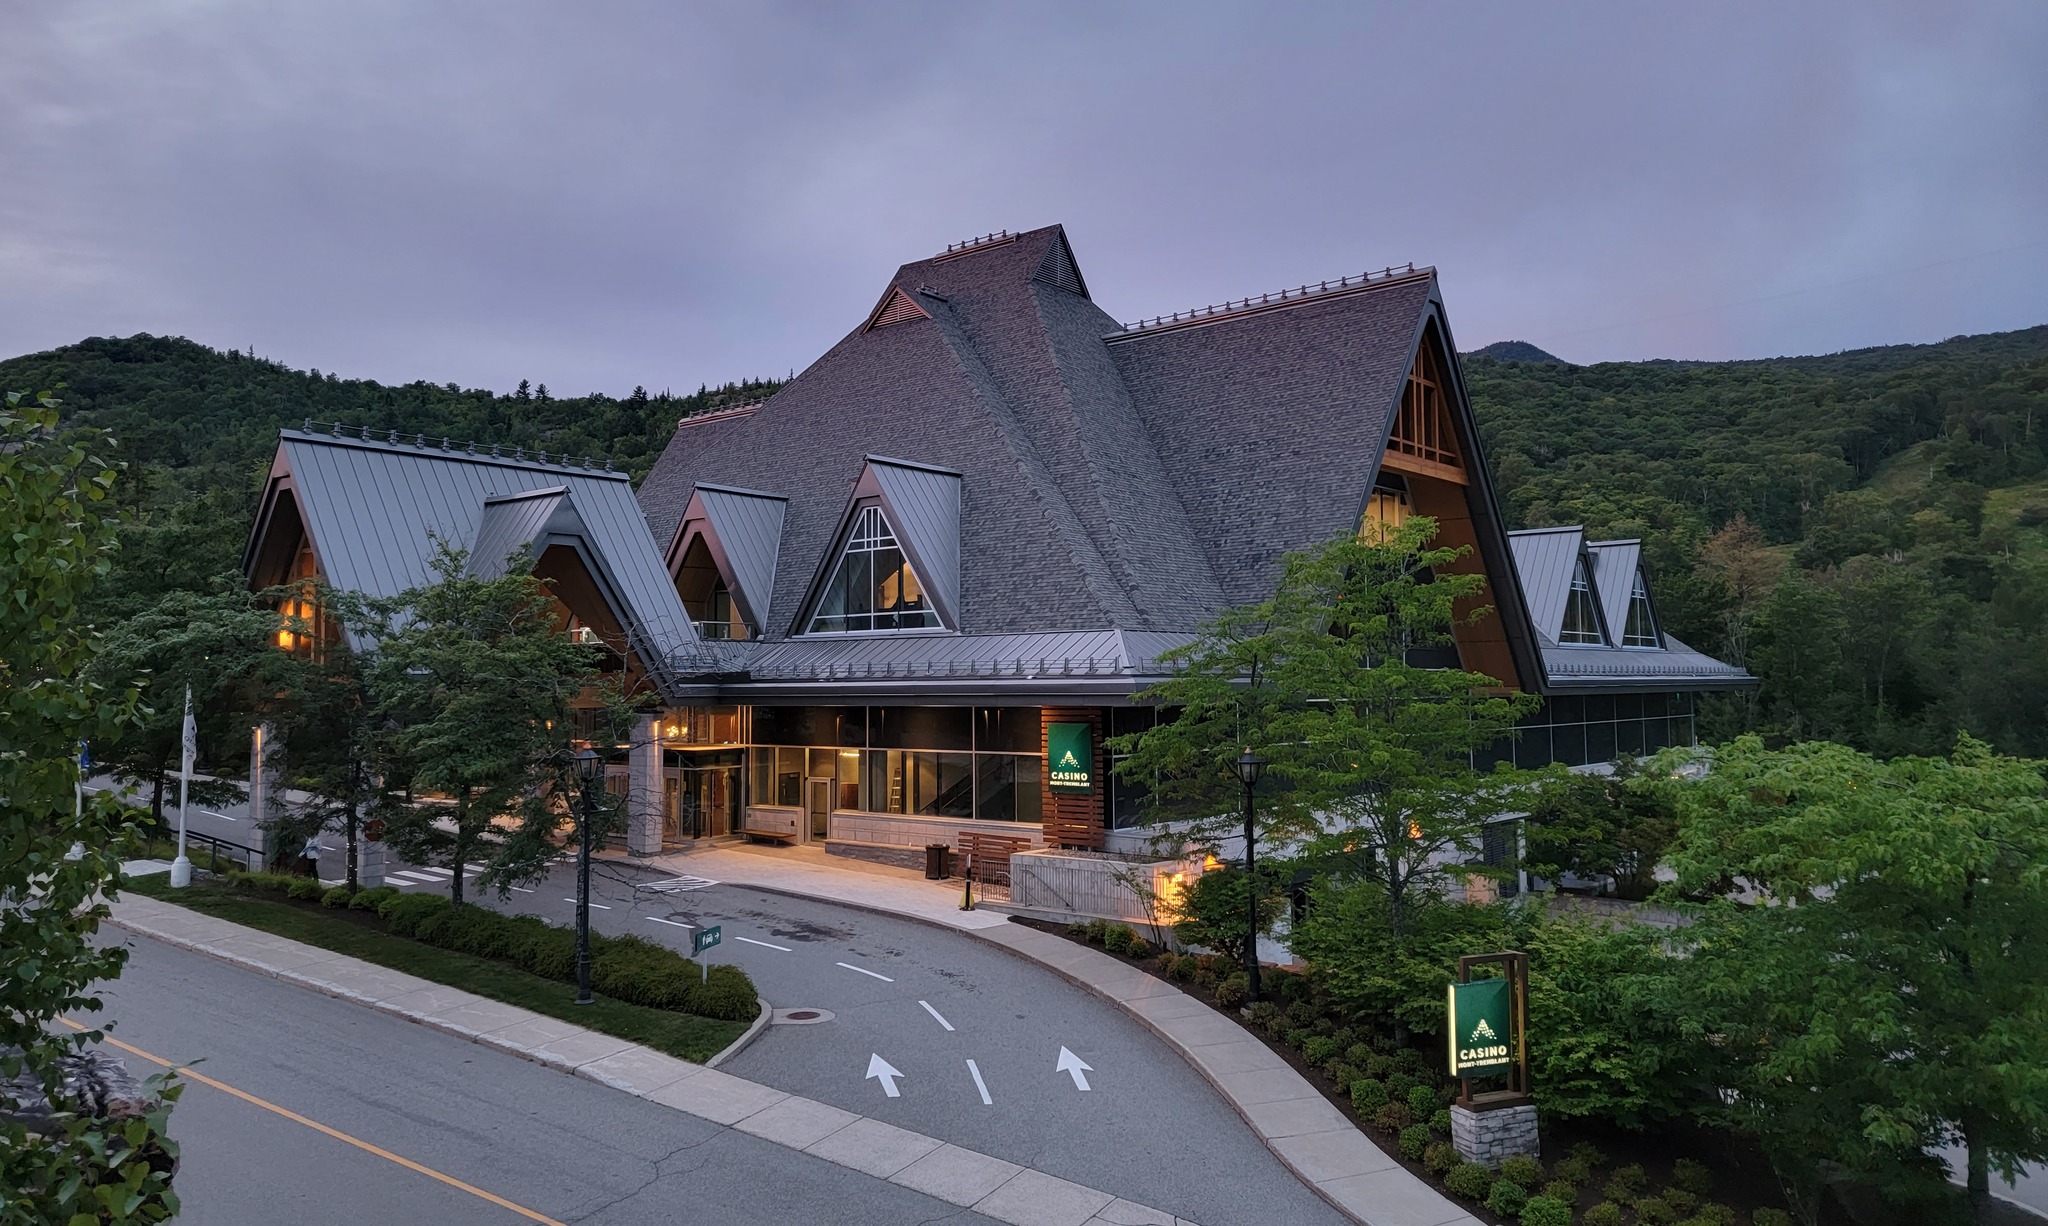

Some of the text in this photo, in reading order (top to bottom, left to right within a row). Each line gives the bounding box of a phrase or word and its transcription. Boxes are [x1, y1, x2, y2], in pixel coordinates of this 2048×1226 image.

[1051, 772, 1088, 781] CASINO
[1460, 1045, 1508, 1060] CASINO
[1458, 1057, 1510, 1068] MONT-TREMBLANT
